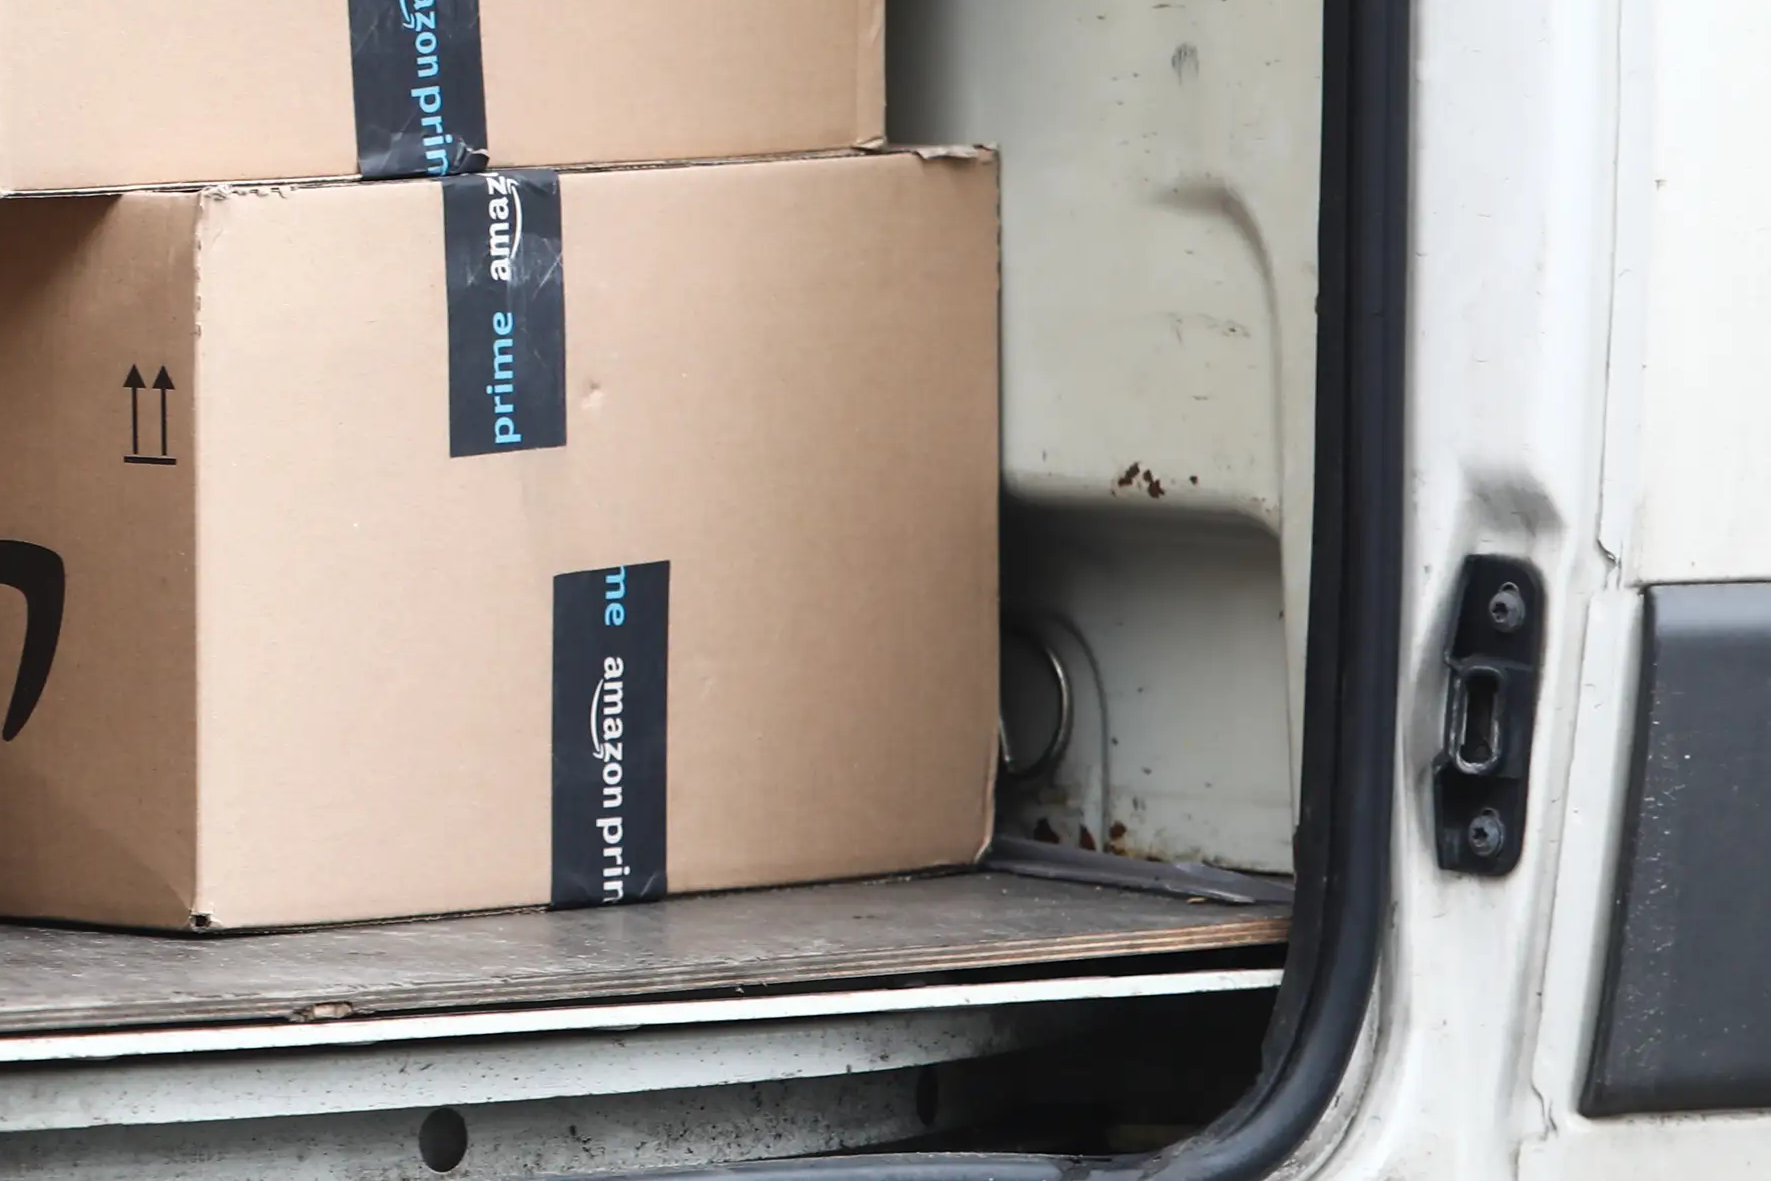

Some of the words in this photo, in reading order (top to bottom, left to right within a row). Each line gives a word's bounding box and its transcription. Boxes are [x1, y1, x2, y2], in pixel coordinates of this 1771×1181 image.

[487, 173, 511, 282] amaz
[486, 311, 522, 444] prime
[602, 656, 624, 809] amazon
